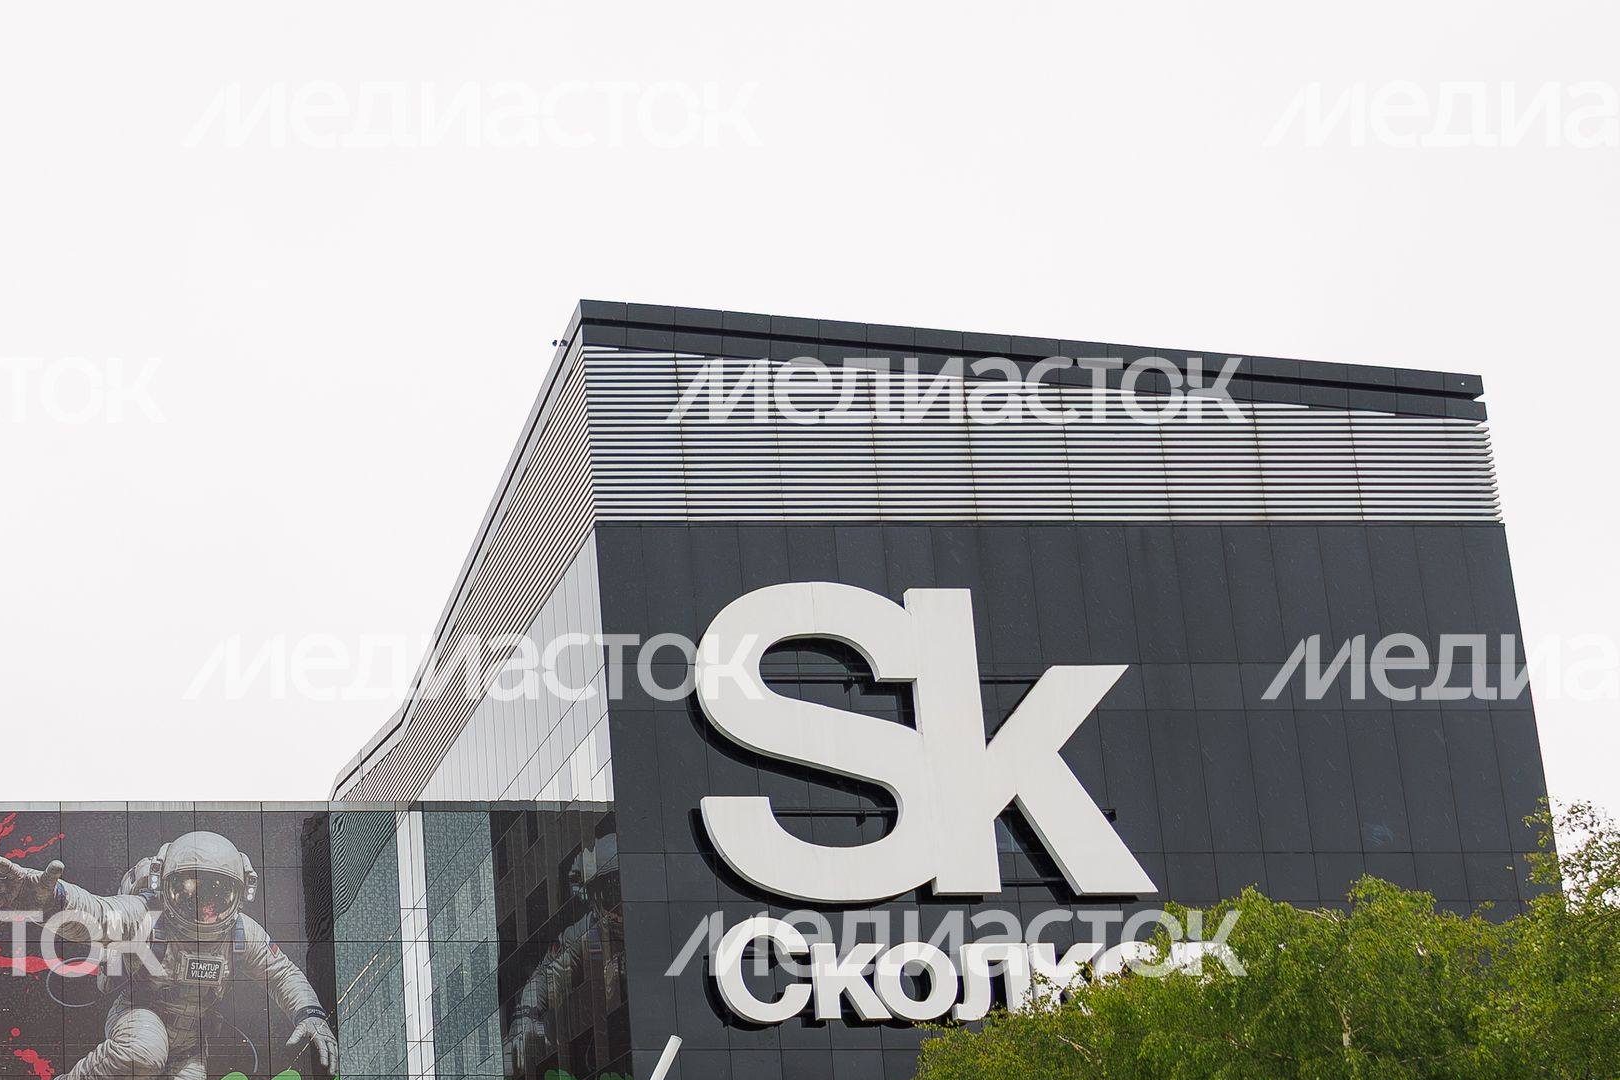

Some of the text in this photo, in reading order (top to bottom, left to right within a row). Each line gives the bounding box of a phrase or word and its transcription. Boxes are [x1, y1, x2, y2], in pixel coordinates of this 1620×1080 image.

[696, 581, 1158, 902] Sk
[190, 962, 220, 971] STARTUP
[190, 970, 217, 979] VILLAGE
